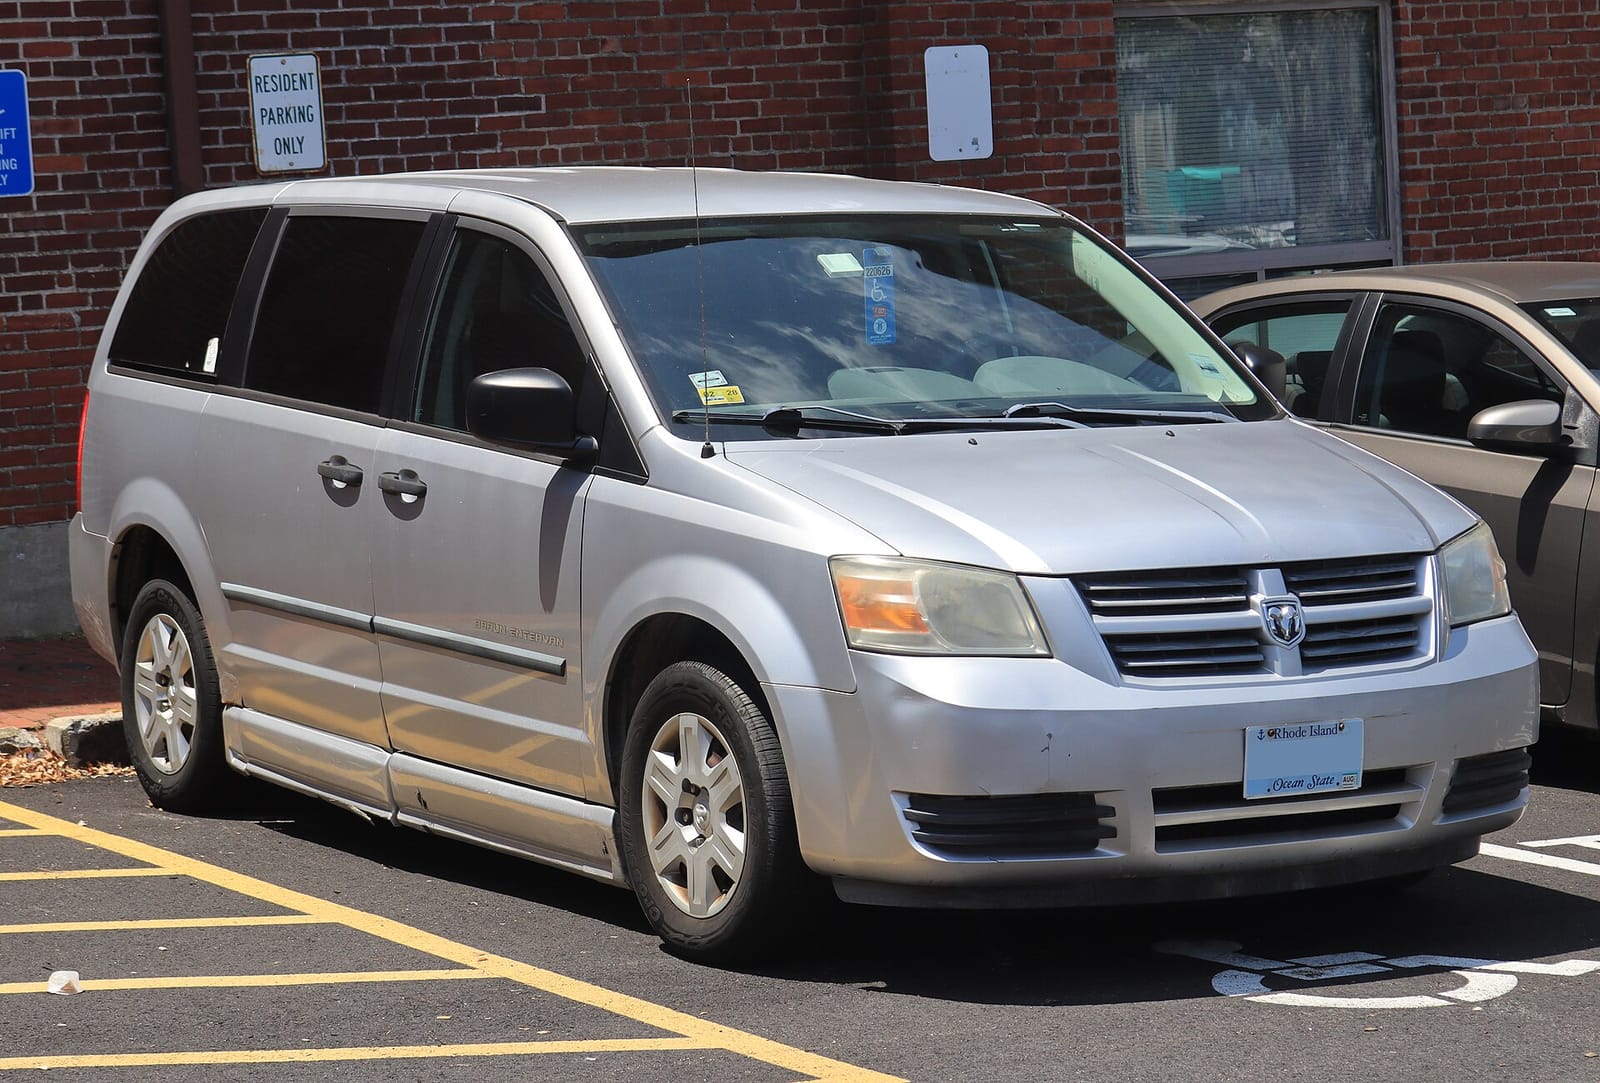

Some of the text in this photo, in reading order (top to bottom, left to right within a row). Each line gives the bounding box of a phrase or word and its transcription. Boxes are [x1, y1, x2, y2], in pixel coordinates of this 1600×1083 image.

[254, 72, 314, 94] RESIDENT
[260, 104, 314, 126] PARKING
[274, 135, 305, 156] ONLY
[865, 266, 891, 277] 220626
[509, 626, 566, 648] ENTERVAN
[1273, 723, 1338, 740] Rhode Island
[1272, 774, 1335, 792] Ocean State
[1342, 775, 1354, 783] AUG
